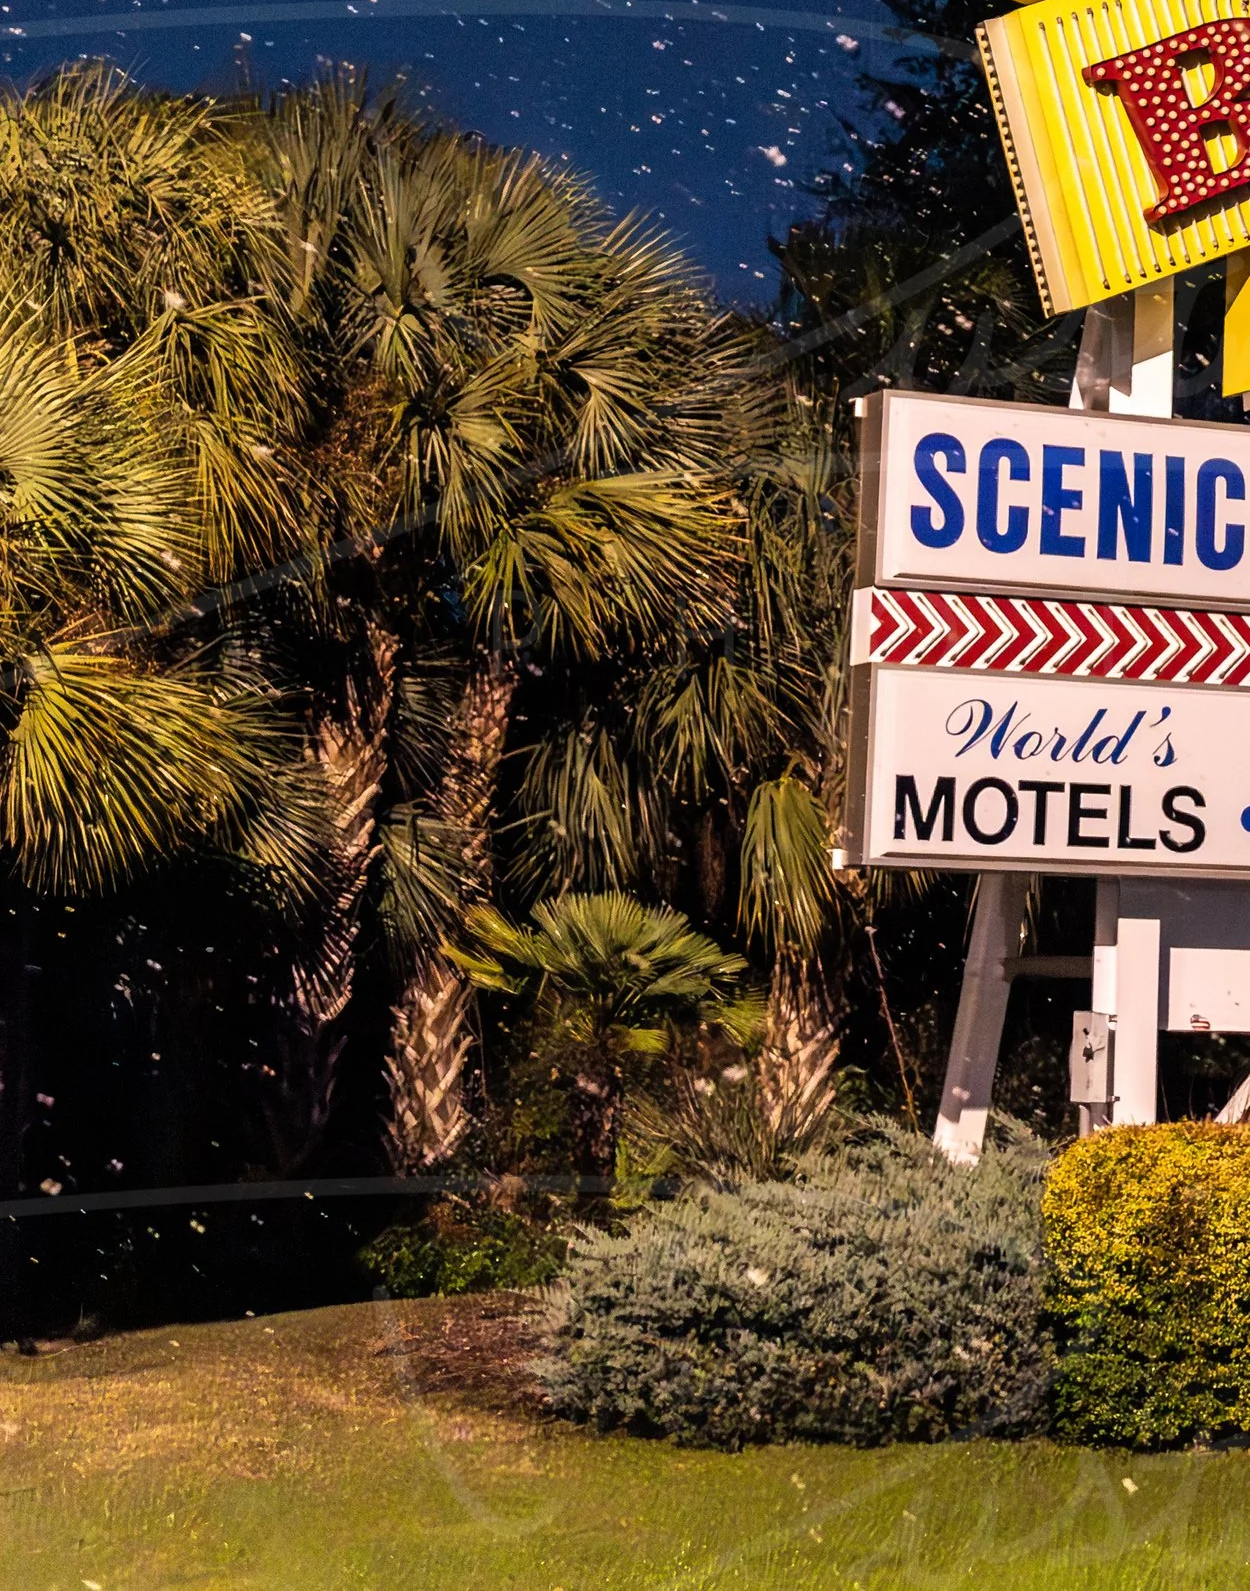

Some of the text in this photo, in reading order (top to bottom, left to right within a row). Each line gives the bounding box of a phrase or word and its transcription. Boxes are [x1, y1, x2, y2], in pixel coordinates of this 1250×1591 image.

[910, 431, 1246, 571] SCENIC
[945, 698, 1177, 767] World's
[893, 774, 1205, 851] MOTELS
